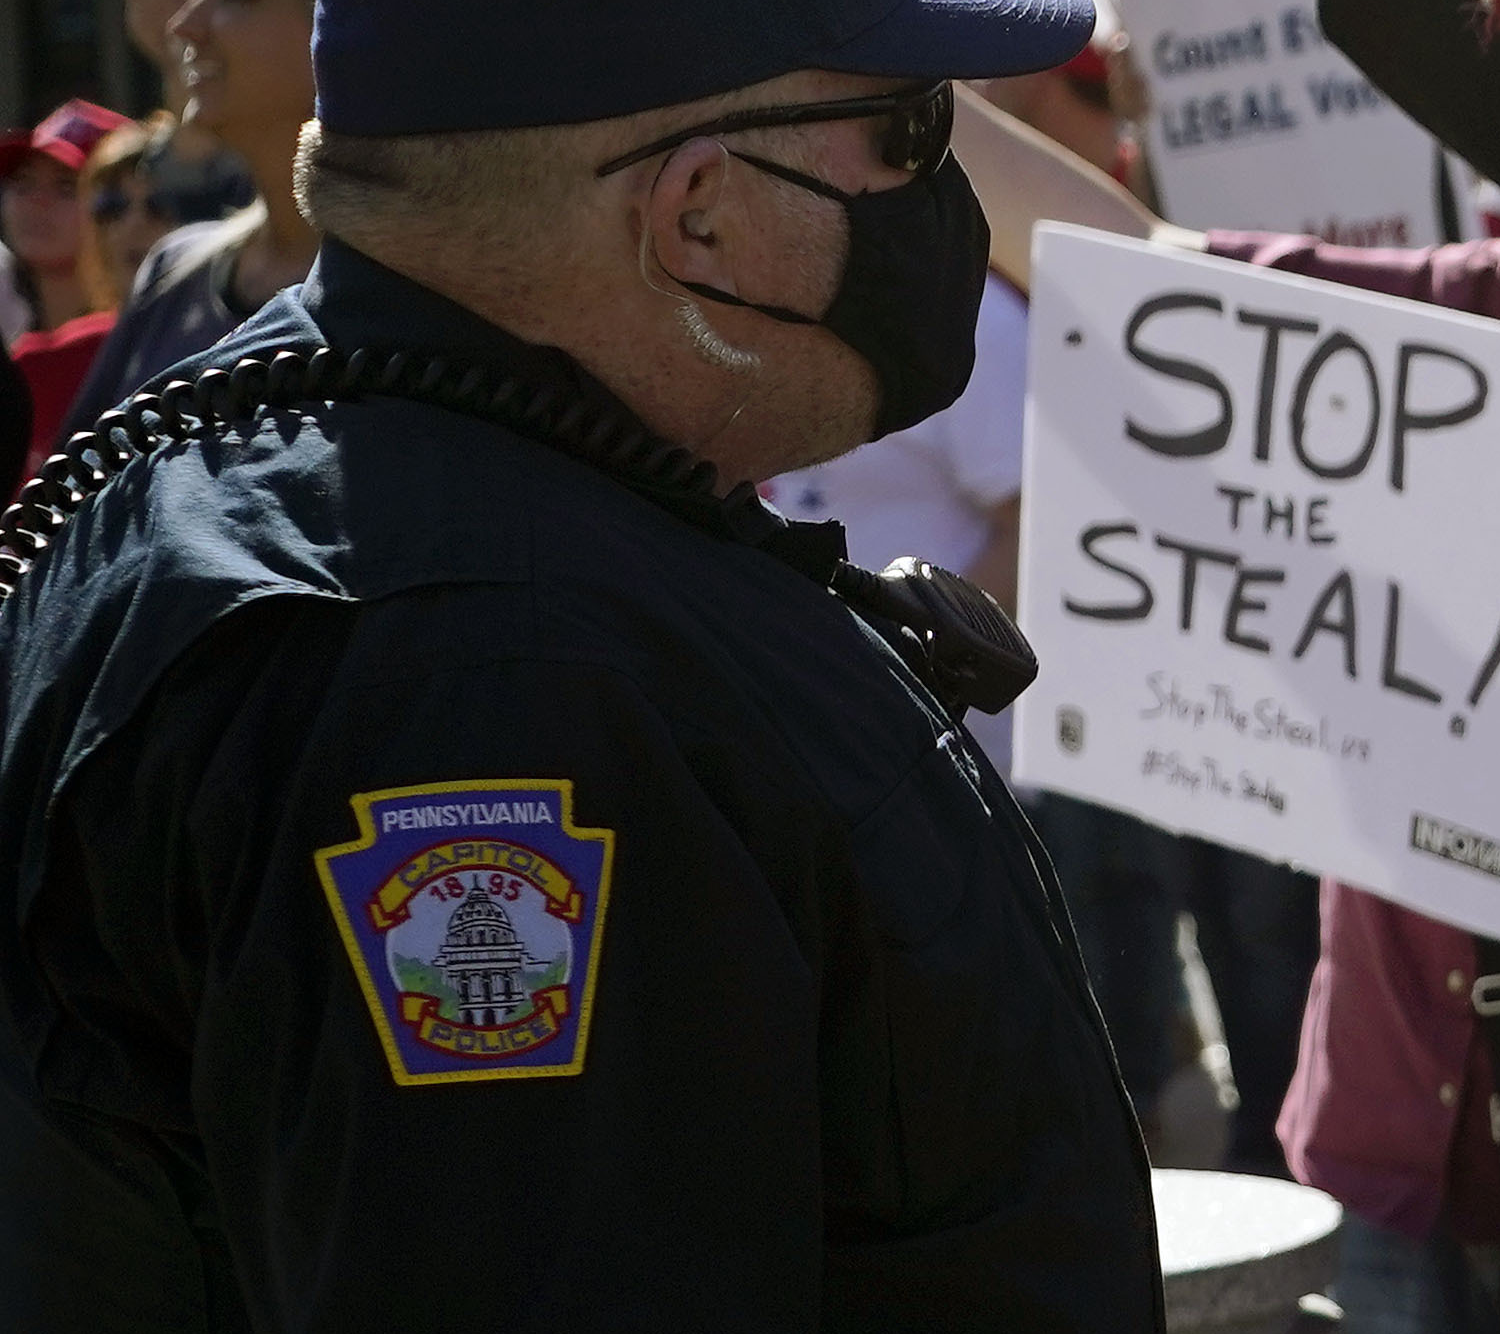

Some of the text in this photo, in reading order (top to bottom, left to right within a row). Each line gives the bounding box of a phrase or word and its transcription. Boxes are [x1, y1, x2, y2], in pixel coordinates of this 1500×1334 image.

[1153, 20, 1267, 78] Count
[1160, 83, 1298, 149] LEGAL
[1124, 294, 1490, 493] STOP
[1216, 485, 1338, 547] THE
[382, 800, 554, 834] PENNSYLVANIA
[400, 842, 549, 889] CAPITOL
[428, 1013, 554, 1055] POLICE
